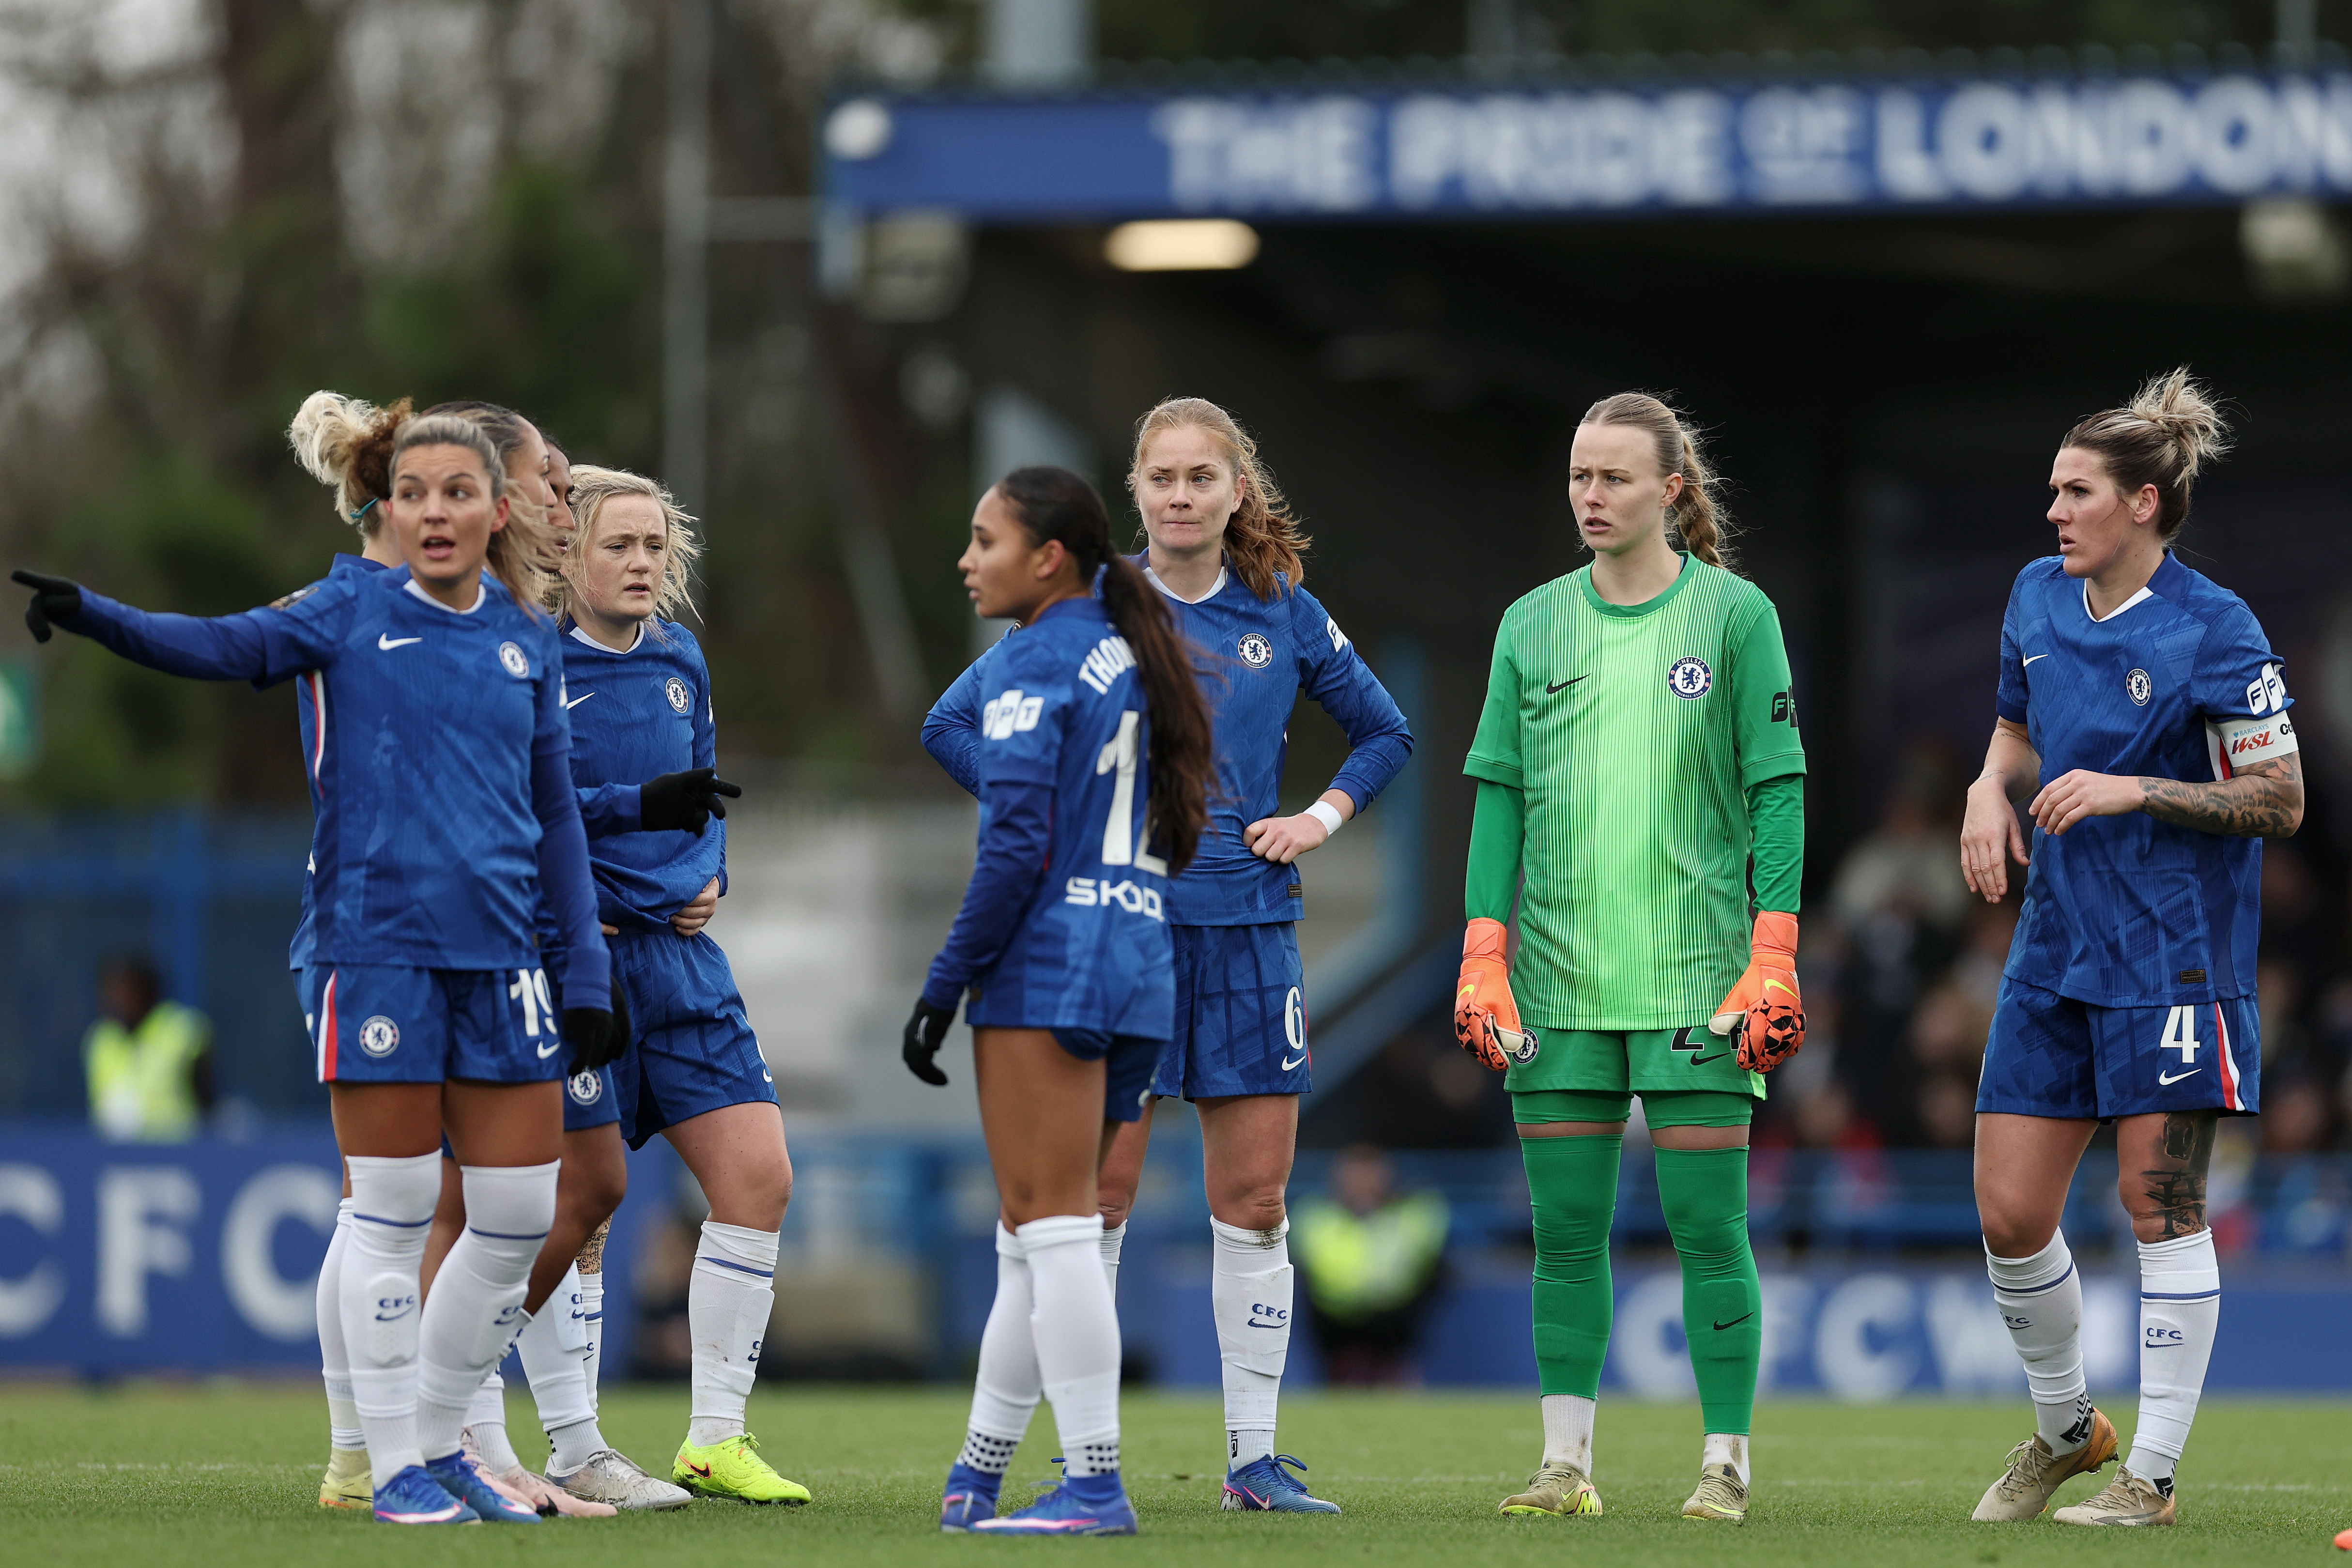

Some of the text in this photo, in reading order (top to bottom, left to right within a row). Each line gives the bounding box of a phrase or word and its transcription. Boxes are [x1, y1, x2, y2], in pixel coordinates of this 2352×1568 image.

[1153, 98, 1378, 212] THE
[1388, 91, 1737, 207] PRIDE
[1875, 75, 2352, 201] LONDON
[1243, 635, 1265, 644] CHELSEA
[1677, 658, 1706, 669] CHELSEA
[2131, 670, 2148, 681] CHELSEA
[668, 679, 683, 688] CHELSEA
[1674, 689, 1692, 698] FOOTBALL
[2239, 723, 2269, 736] BARCLAYS
[2231, 730, 2275, 754] WSL
[509, 968, 558, 1037] 19
[1285, 986, 1304, 1050] 6
[2160, 1005, 2200, 1063] 4
[379, 1295, 415, 1309] CFC
[1252, 1303, 1287, 1320] CFC
[2147, 1327, 2183, 1340] CFC
